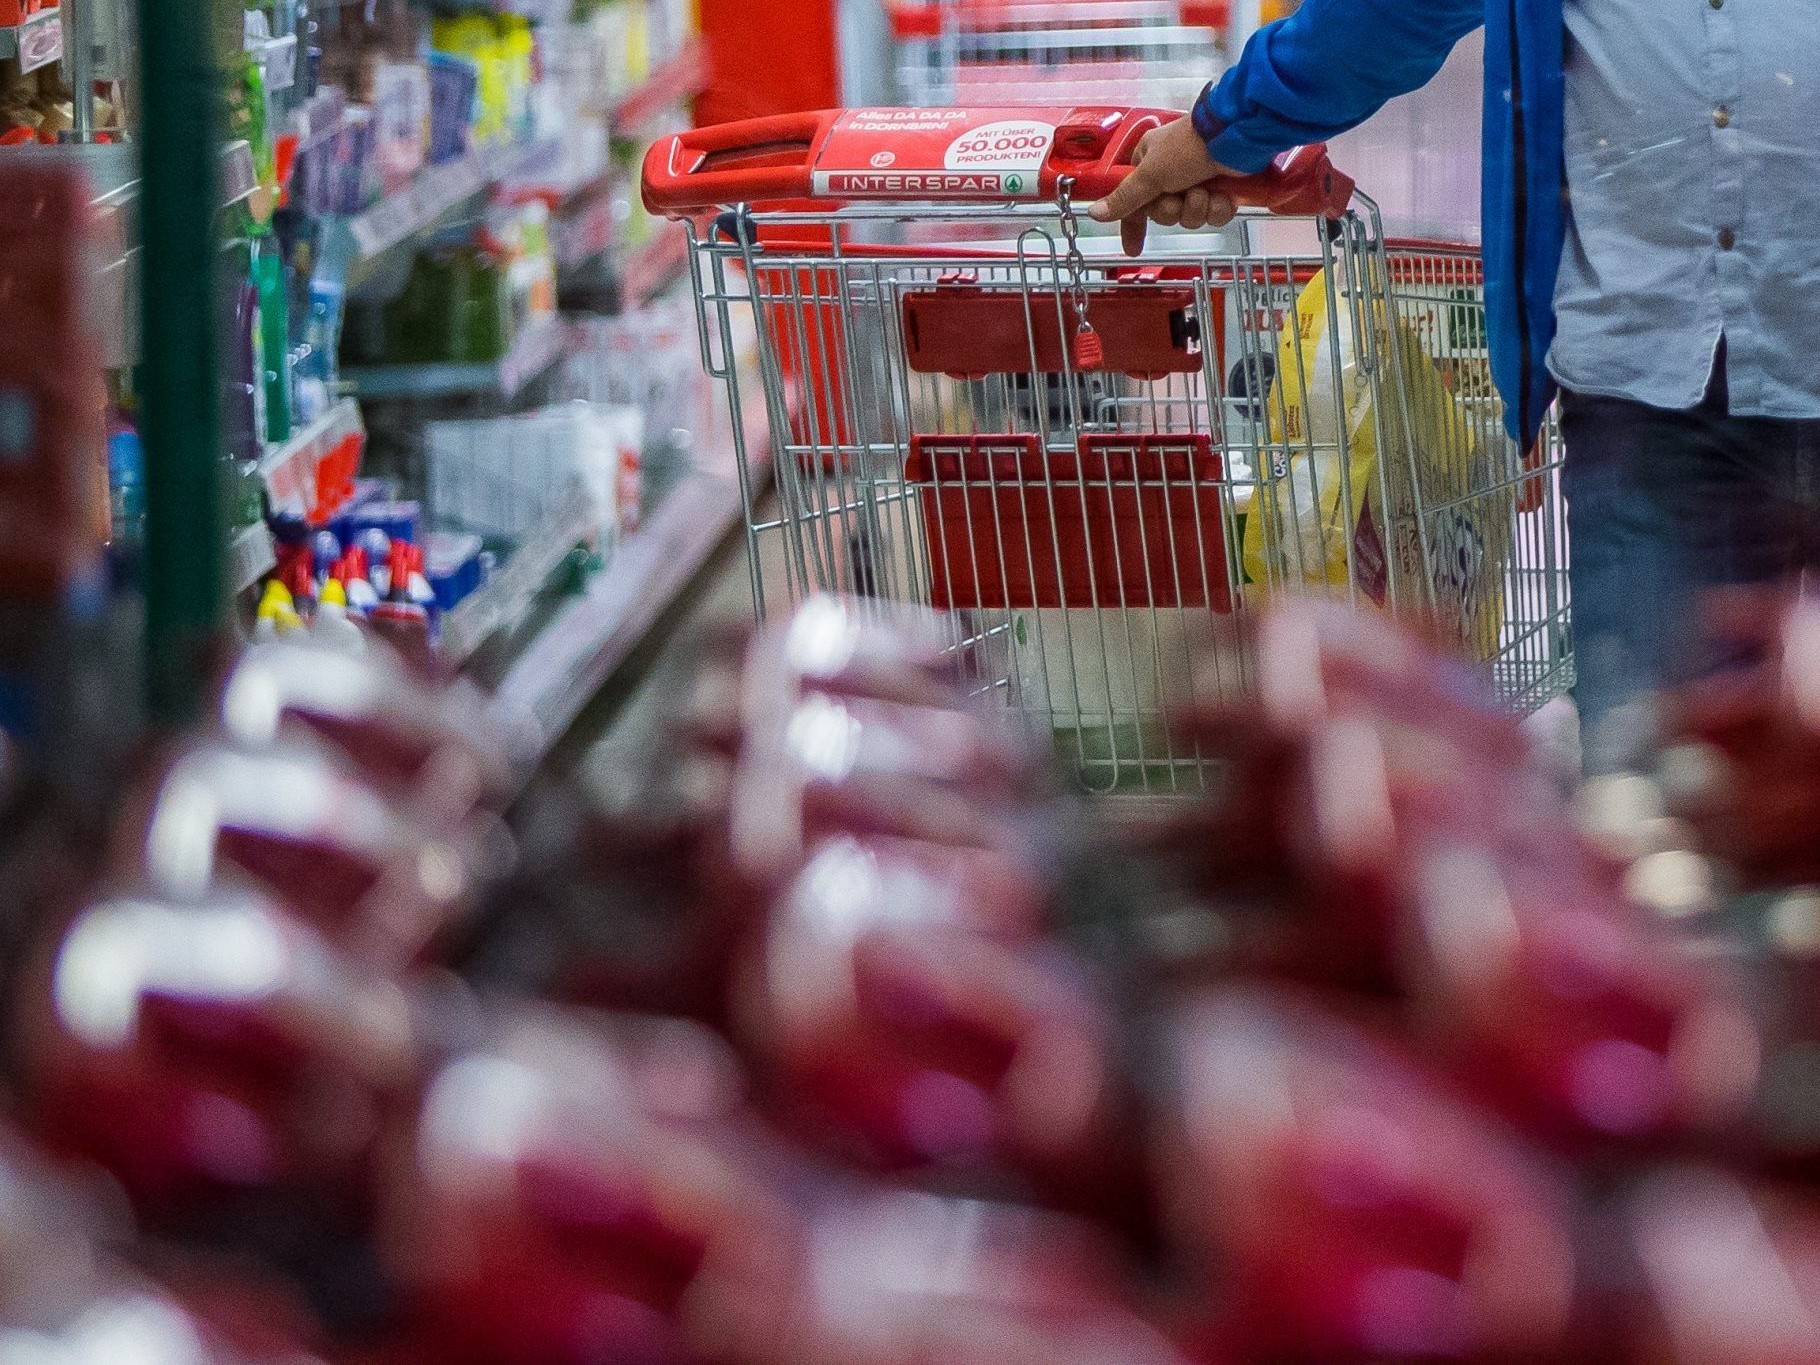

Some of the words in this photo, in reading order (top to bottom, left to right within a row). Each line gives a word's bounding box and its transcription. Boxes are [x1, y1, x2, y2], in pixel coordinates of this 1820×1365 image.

[856, 111, 892, 120] Alles
[893, 111, 916, 120] DA
[918, 111, 942, 120] DA
[943, 111, 967, 119] DA
[864, 121, 950, 131] DORNBIRN!
[975, 130, 1000, 138] MIT
[956, 135, 1048, 153] 50.000
[956, 151, 1042, 163] PRODUKTEN!
[843, 175, 999, 191] INTERSPAR
